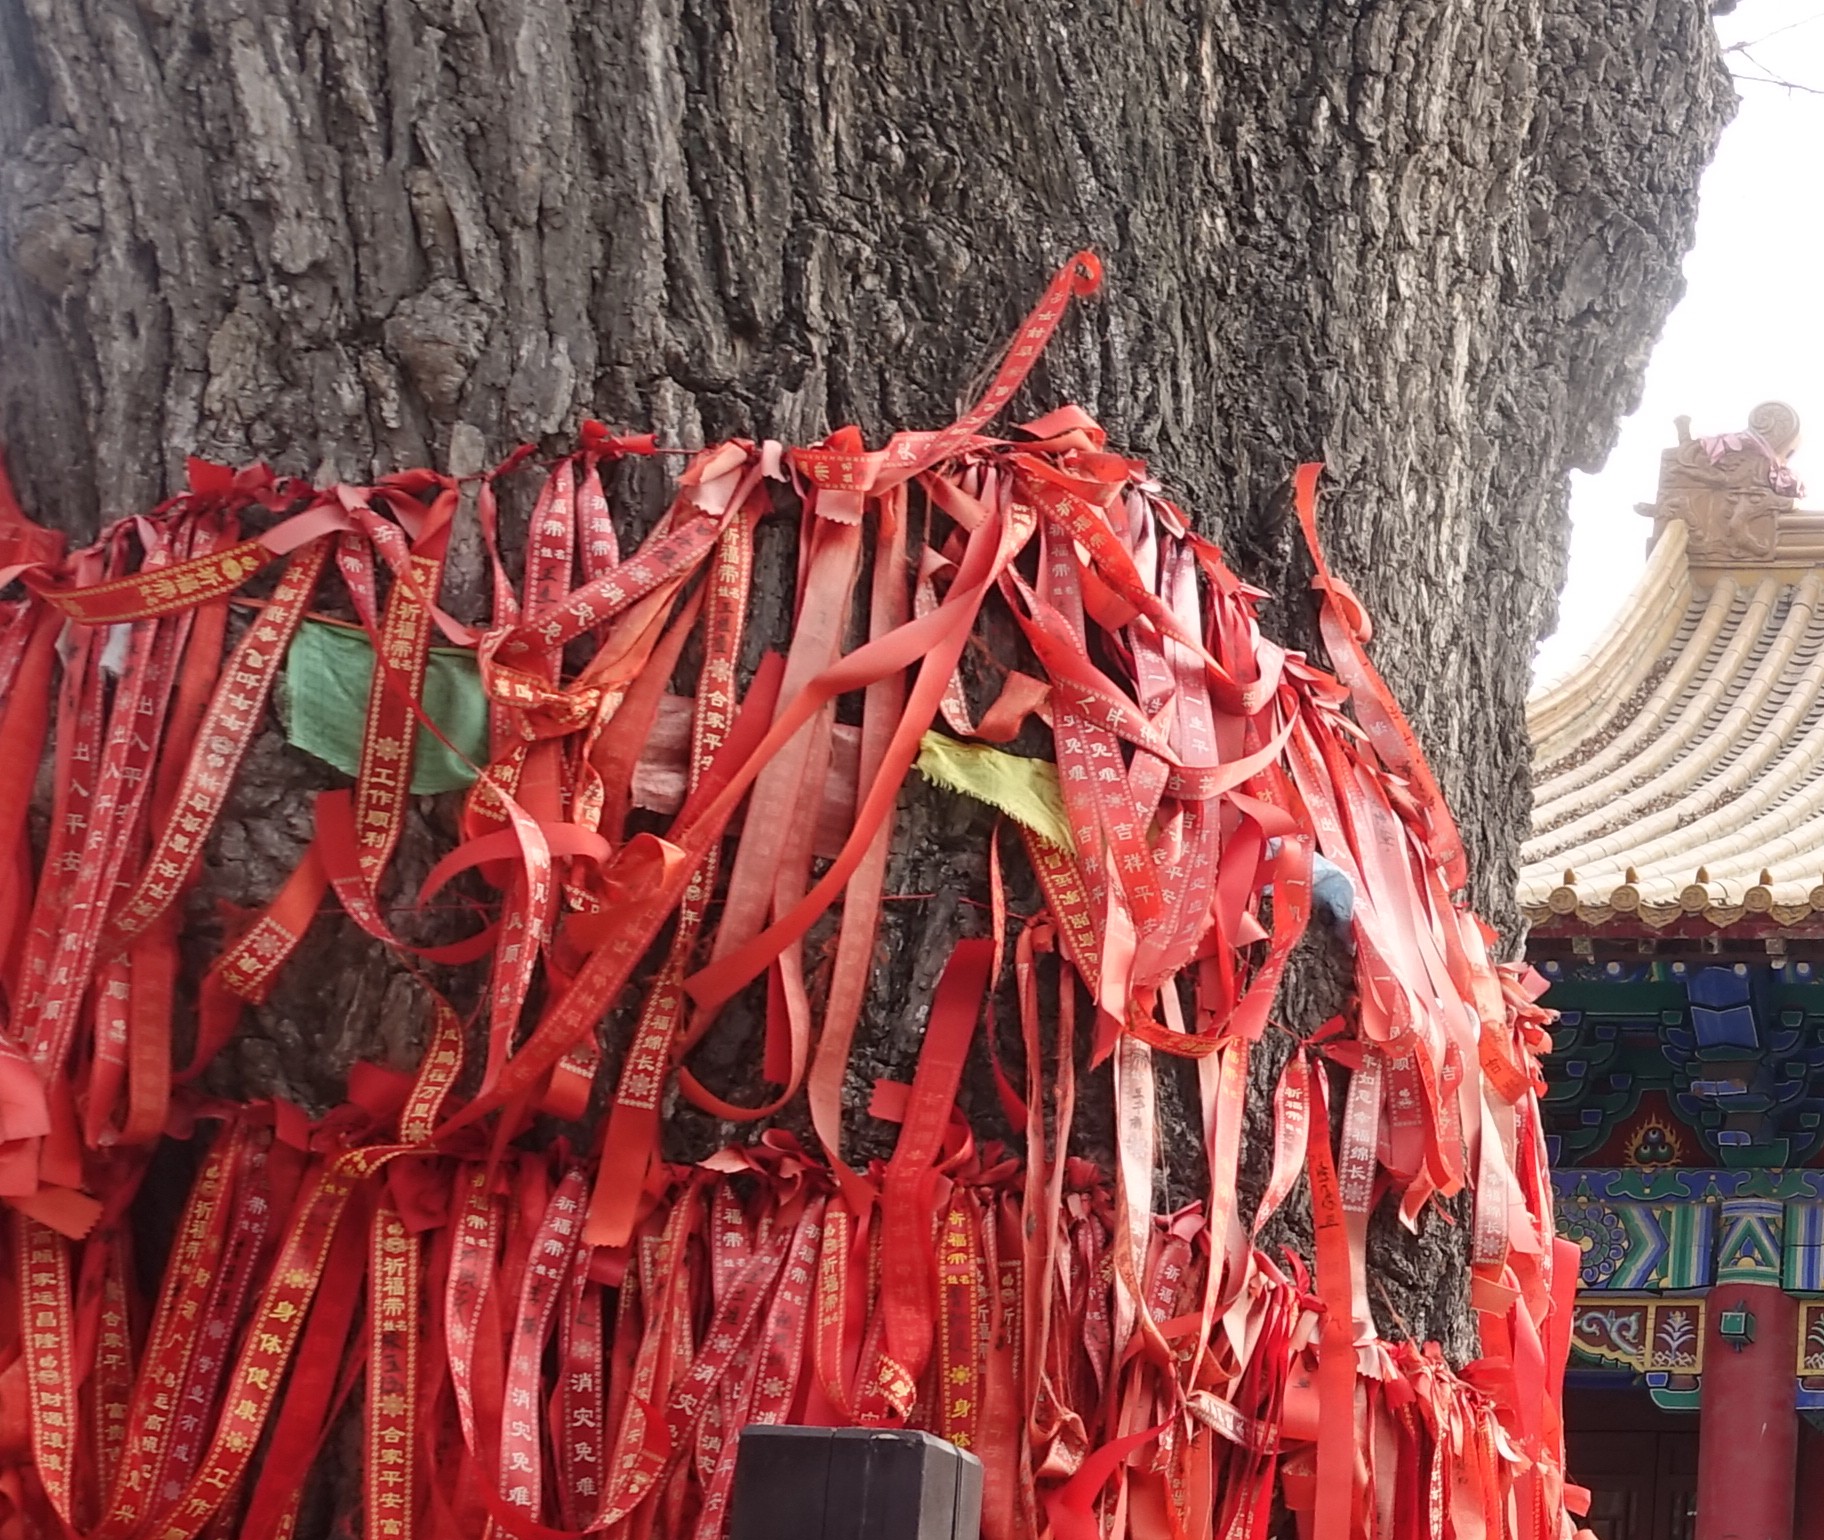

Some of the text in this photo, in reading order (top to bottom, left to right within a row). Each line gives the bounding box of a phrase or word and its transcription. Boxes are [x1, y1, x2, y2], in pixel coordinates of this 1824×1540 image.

[719, 527, 740, 583] 祈福带
[391, 602, 421, 658] 祈福带
[361, 767, 395, 848] 工作顺利
[545, 1196, 577, 1257] 祈福带
[947, 1210, 967, 1265] 祈福带
[383, 1256, 406, 1317] 祈福带
[234, 1300, 297, 1421] 身体健康
[508, 1387, 533, 1507] 消灾免难
[571, 1373, 597, 1497] 消灾免难
